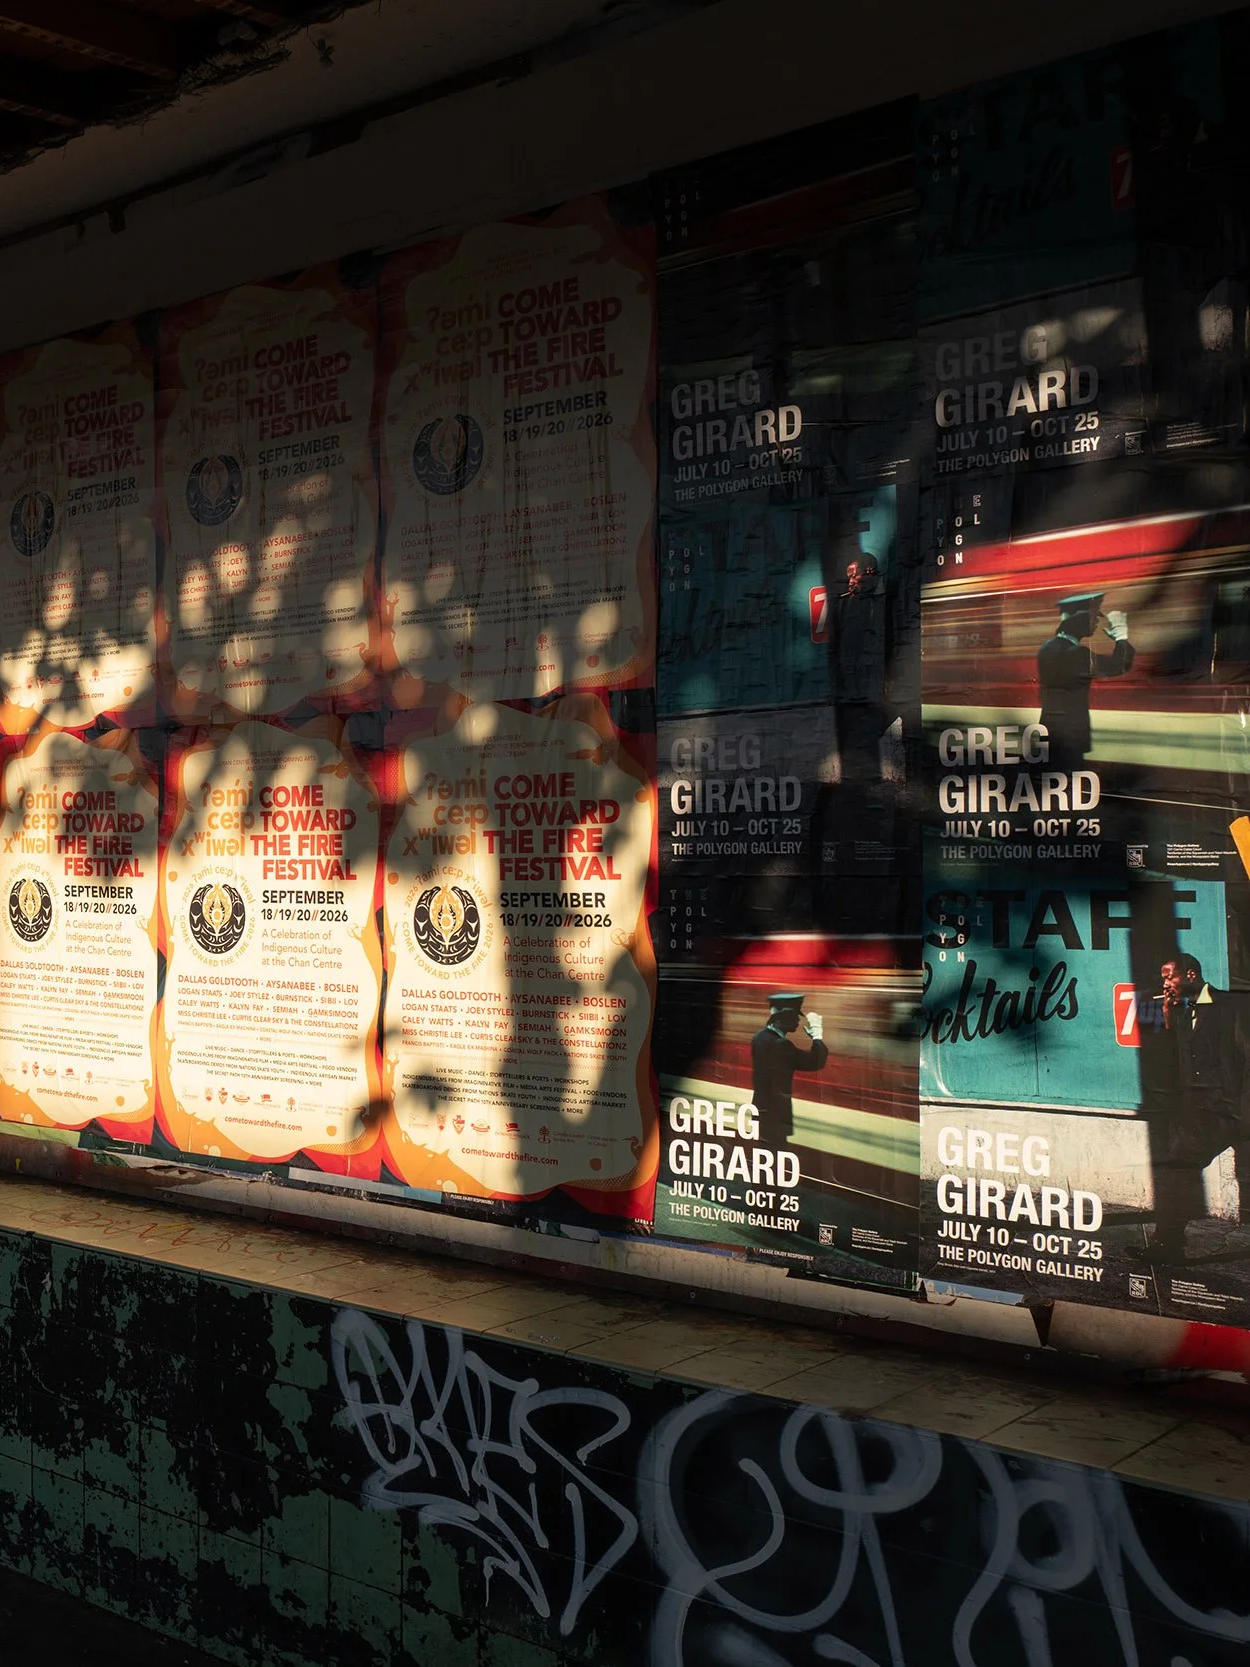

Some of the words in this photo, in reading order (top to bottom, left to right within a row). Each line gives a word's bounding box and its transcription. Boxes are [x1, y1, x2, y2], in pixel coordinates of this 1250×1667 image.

[498, 276, 580, 318] COME
[498, 297, 622, 345] TOWARD
[254, 334, 318, 370] COME
[488, 341, 538, 374] THE
[547, 328, 606, 363] FIRE
[934, 324, 1047, 382] GREG
[503, 353, 623, 399] FESTIVAL
[64, 384, 118, 416] COME
[503, 391, 608, 425] SEPTEMBER
[671, 370, 761, 420] GREG
[935, 364, 1099, 428] GIRARD
[259, 401, 352, 442] FESTIVAL
[503, 412, 614, 444] 18/19/20//2026
[672, 404, 803, 461] GIRARD
[937, 431, 979, 453] JULY
[986, 426, 1008, 445] 10
[1031, 416, 1069, 438] OCT
[1074, 411, 1099, 432] 25
[258, 435, 340, 465] SEPTEMBER
[937, 458, 963, 473] THE
[967, 447, 1030, 469] POLYGON
[1034, 436, 1100, 458] GALLERY
[674, 464, 706, 484] JULY
[712, 460, 730, 476] 10
[750, 449, 778, 470] OCT
[782, 447, 803, 465] 25
[68, 477, 136, 501] SEPTEMBER
[674, 487, 695, 502] THE
[698, 478, 750, 498] POLYGON
[752, 470, 804, 489] GALLERY
[670, 734, 761, 773] GREG
[938, 723, 1049, 768] GREG
[62, 791, 116, 811] COME
[259, 785, 324, 808] COME
[494, 772, 575, 801] COME
[670, 776, 802, 816] GIRARD
[938, 770, 1101, 814] GIRARD
[63, 813, 144, 833] TOWARD
[260, 809, 356, 831] TOWARD
[495, 799, 621, 826] TOWARD
[483, 829, 539, 854] THE
[543, 828, 603, 854] FIRE
[671, 820, 706, 837] JULY
[711, 820, 730, 836] 10
[748, 820, 778, 836] OCT
[782, 819, 800, 834] 25
[940, 820, 983, 838] JULY
[988, 820, 1010, 837] 10
[1033, 819, 1071, 837] OCT
[1076, 818, 1100, 836] 25
[55, 835, 88, 854] THE
[92, 835, 133, 855] FIRE
[250, 835, 291, 856] THE
[298, 835, 343, 856] FIRE
[672, 843, 694, 856] THE
[696, 842, 748, 855] POLYGON
[750, 842, 802, 854] GALLERY
[941, 845, 966, 859] THE
[969, 845, 1032, 859] POLYGON
[1037, 844, 1101, 859] GALLERY
[64, 857, 144, 877] FESTIVAL
[263, 859, 357, 881] FESTIVAL
[499, 856, 622, 881] FESTIVAL
[64, 885, 133, 899] SEPTEMBER
[262, 890, 344, 905] SEPTEMBER
[500, 892, 606, 908] SEPTEMBER
[64, 901, 137, 915] 18/19/20//2026
[261, 909, 348, 922] 18/19/20//2026
[500, 913, 612, 927] 18/19/20//2026
[925, 889, 1197, 950] STAF
[503, 936, 511, 946] A
[513, 936, 576, 948] Celebration
[580, 937, 591, 948] of
[504, 952, 561, 965] Indigenous
[564, 953, 604, 965] Culture
[505, 969, 513, 978] at
[516, 967, 534, 979] the
[537, 967, 565, 981] Chan
[568, 969, 605, 982] Centre
[401, 989, 436, 999] DALLAS
[439, 990, 501, 1002] GOLDTOOTH
[511, 994, 571, 1006] AYSANABEE
[583, 997, 627, 1008] BOSLEN
[401, 1003, 428, 1012] LOGAN
[430, 1004, 458, 1014] STAATS
[522, 1009, 569, 1020] BURNSTICK
[465, 1019, 490, 1028] KALYN
[518, 1023, 551, 1032] SEMIAH
[669, 1096, 760, 1141] GREG
[461, 1147, 558, 1165] cometowardthefire.com
[668, 1139, 800, 1189] GIRARD
[937, 1126, 1050, 1177] GREG
[669, 1180, 705, 1200] JULY
[708, 1186, 728, 1202] 10
[747, 1190, 776, 1210] OCT
[780, 1194, 800, 1213] 25
[937, 1174, 1103, 1233] GIRARD
[670, 1202, 692, 1216] THE
[693, 1206, 745, 1224] POLYGON
[748, 1214, 800, 1232] GALLERY
[937, 1220, 981, 1242] JULY
[986, 1227, 1010, 1246] 10
[1033, 1232, 1072, 1255] OCT
[1078, 1239, 1103, 1261] 25
[937, 1244, 965, 1261] THE
[967, 1248, 1032, 1271] POLYGON
[1036, 1259, 1103, 1282] GALLERY
